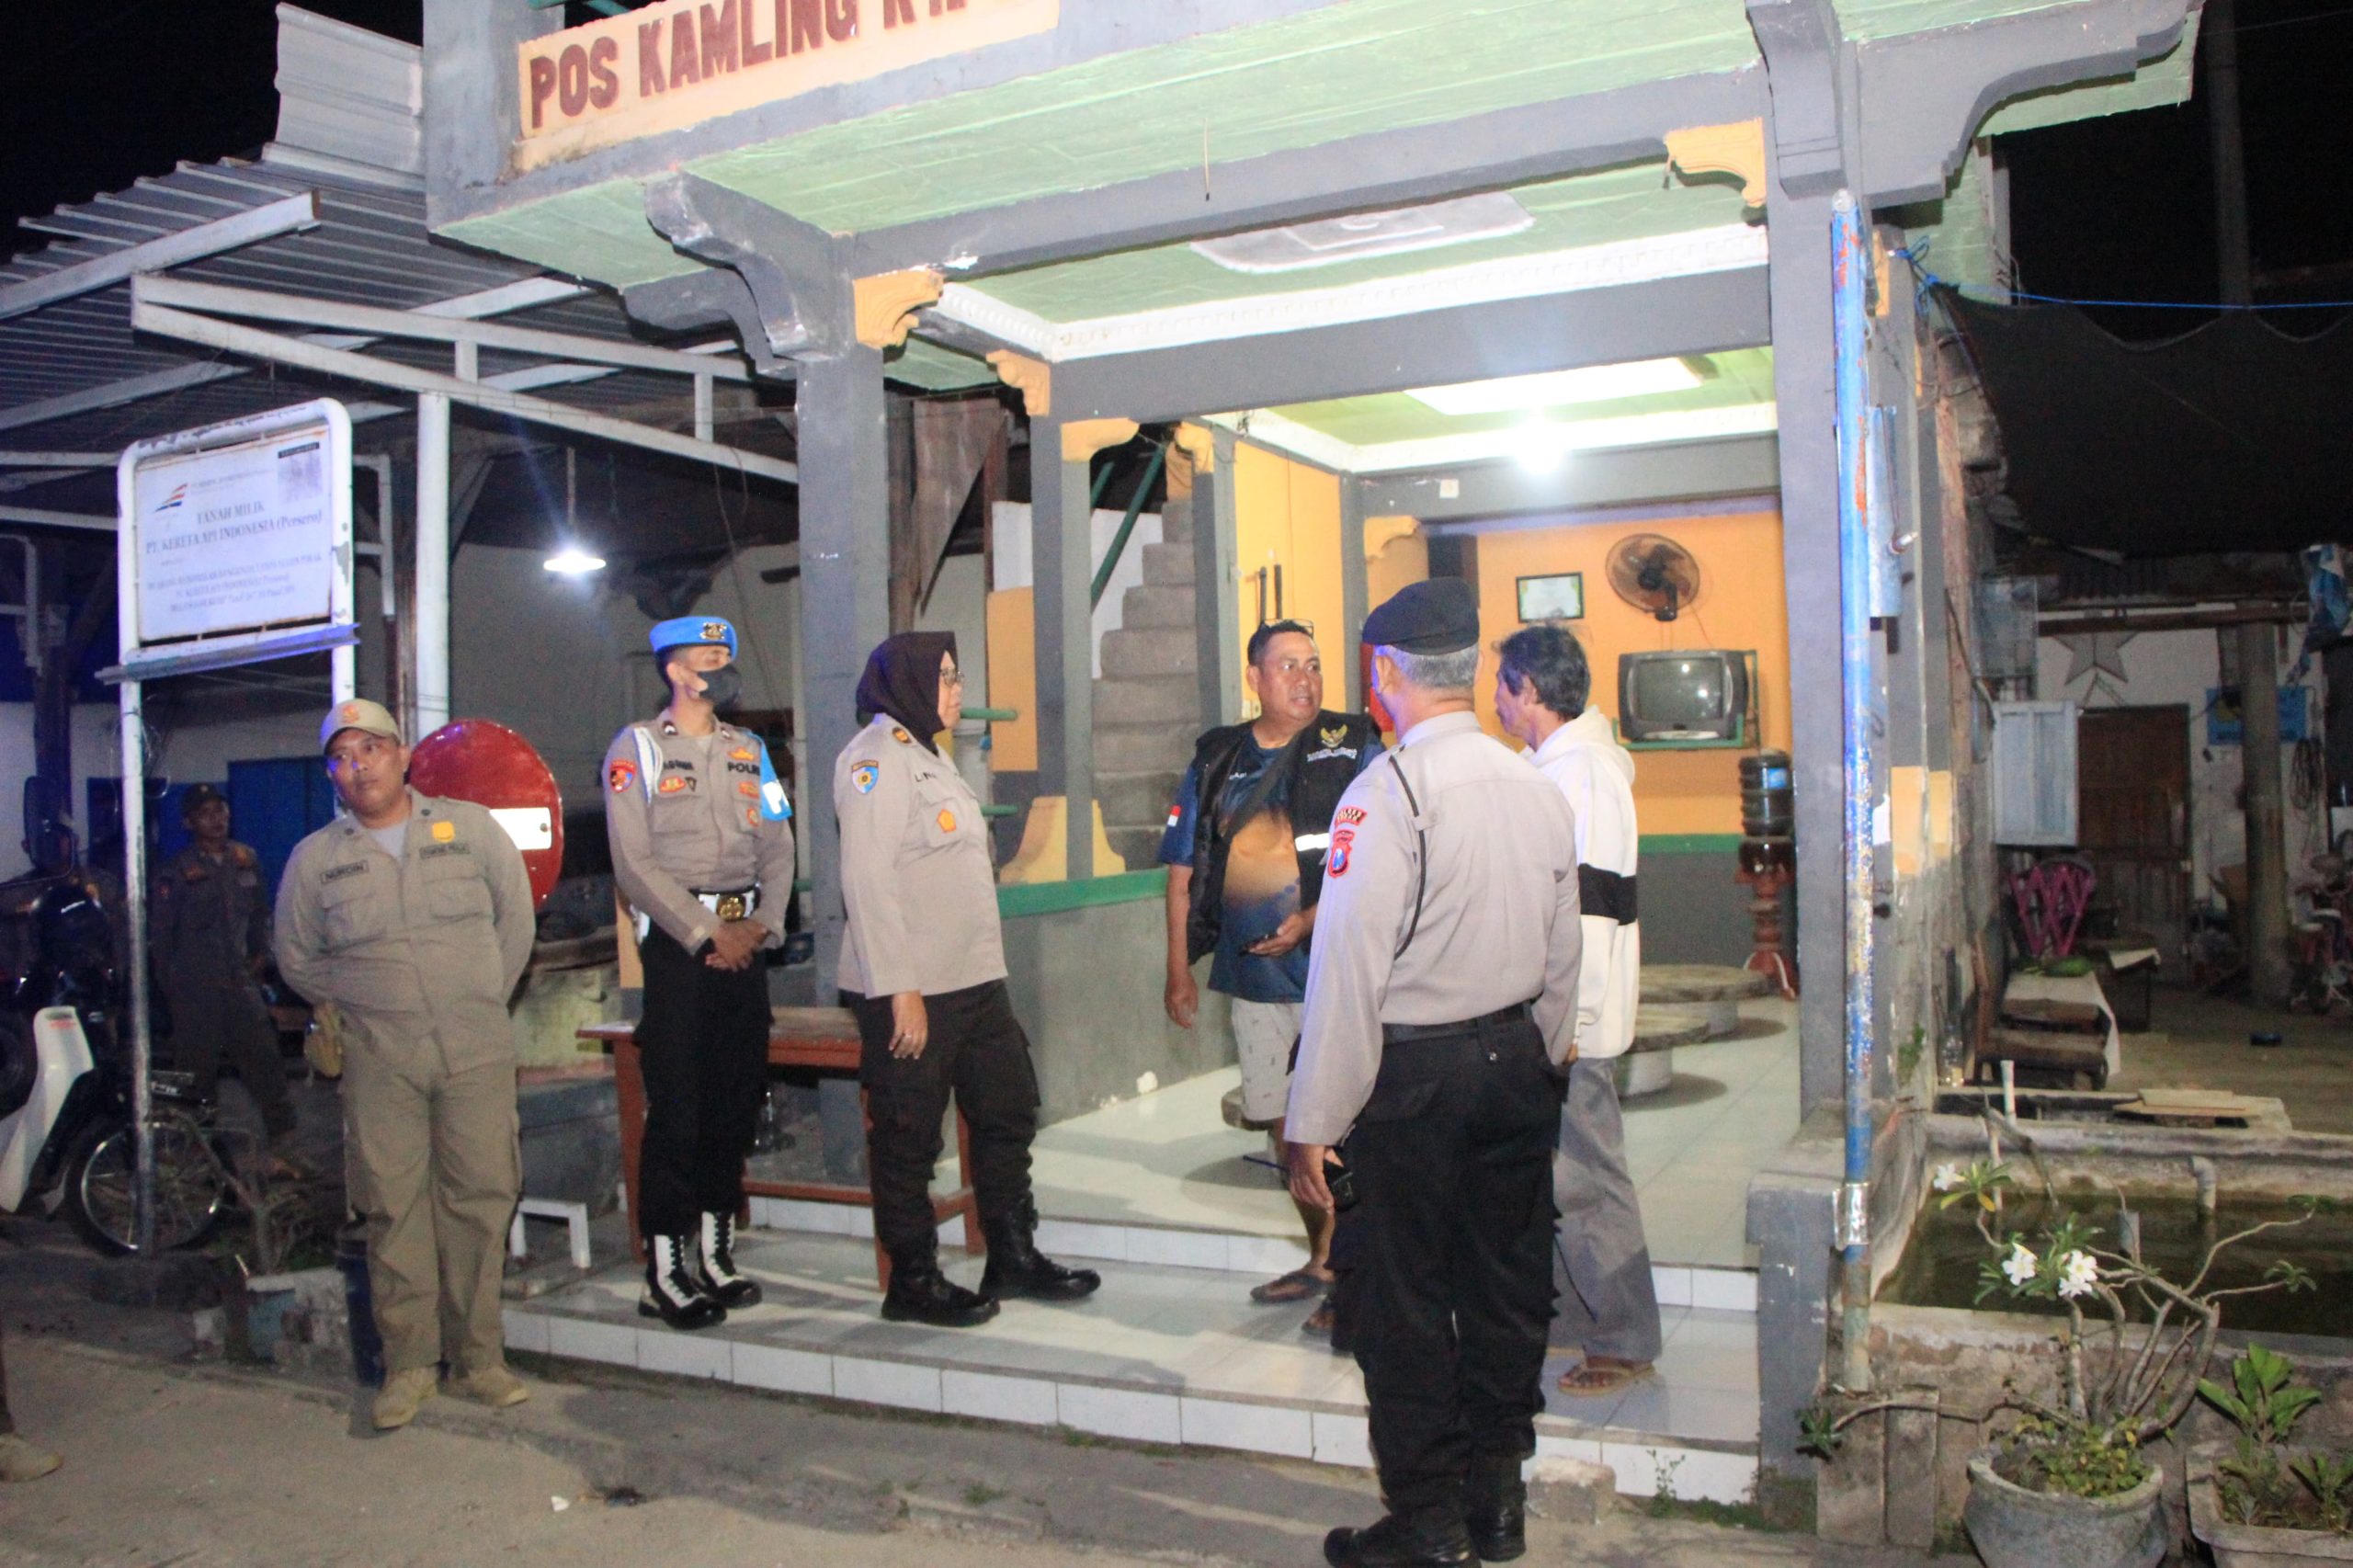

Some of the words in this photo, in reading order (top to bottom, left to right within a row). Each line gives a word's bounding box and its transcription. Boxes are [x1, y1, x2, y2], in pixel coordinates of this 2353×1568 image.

[529, 36, 619, 129] POS
[639, 0, 859, 97] KAMLING
[197, 504, 231, 525] TANAH
[233, 500, 265, 517] MILIK
[162, 534, 199, 551] KERETA
[200, 529, 218, 545] API
[219, 517, 275, 540] INDONESIA
